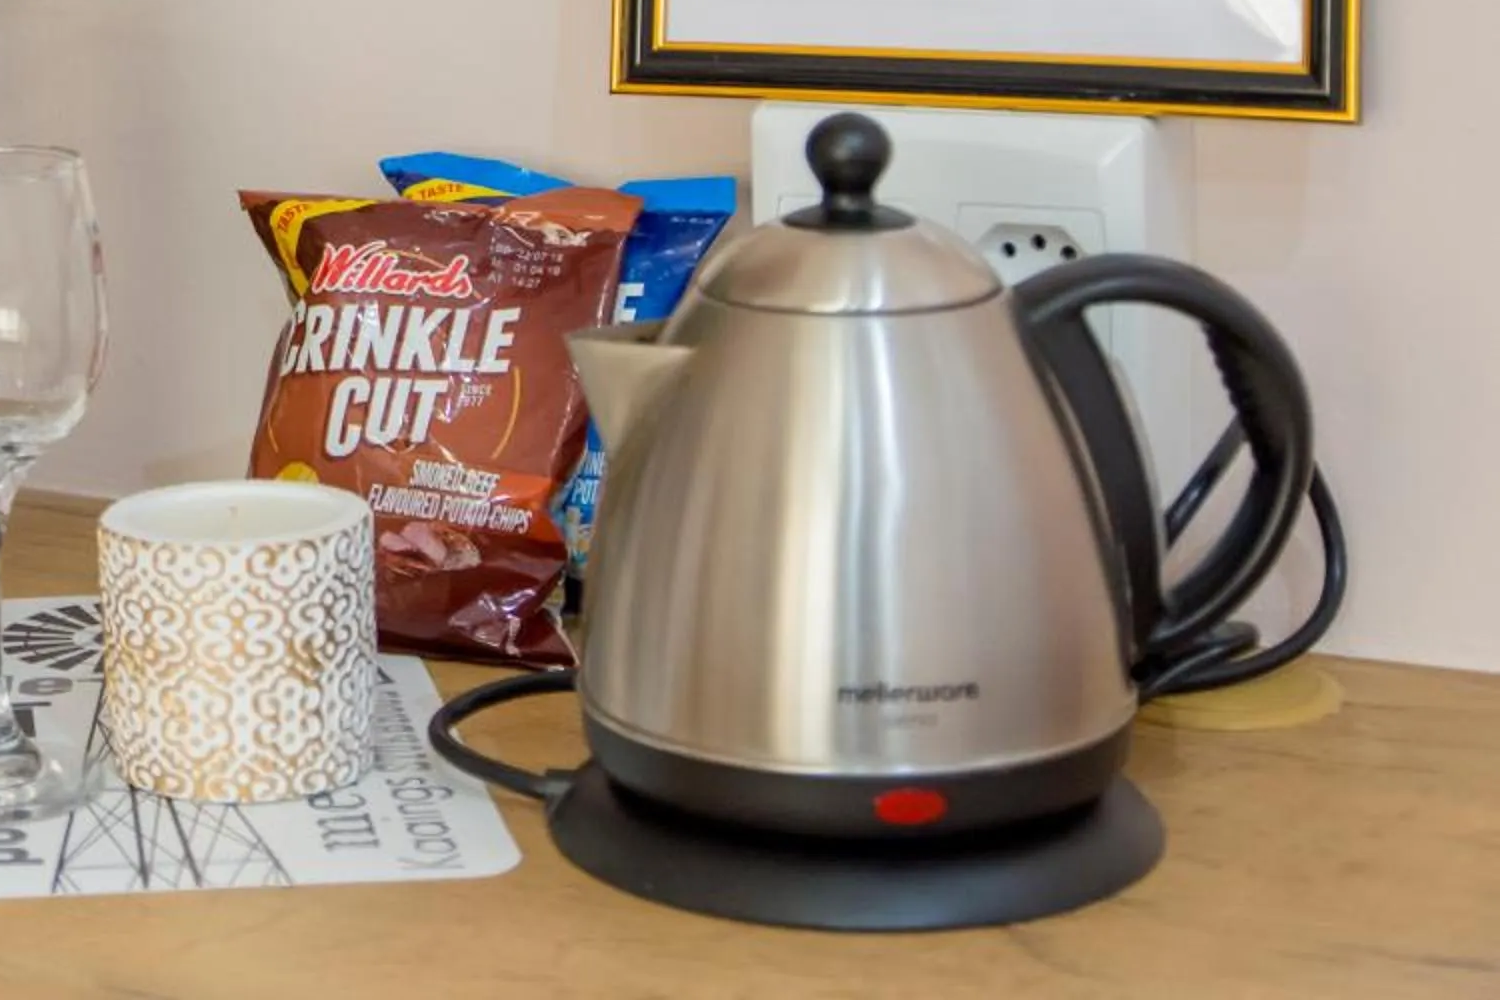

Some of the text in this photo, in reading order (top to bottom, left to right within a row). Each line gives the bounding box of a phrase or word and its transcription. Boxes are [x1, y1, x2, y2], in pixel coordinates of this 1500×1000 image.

[311, 240, 475, 298] Willards
[279, 300, 522, 376] CRINKLE
[325, 375, 449, 458] CUT
[410, 459, 501, 499] SMOKED BEEF
[368, 483, 534, 535] FLAVOURED POTATO CHIPS
